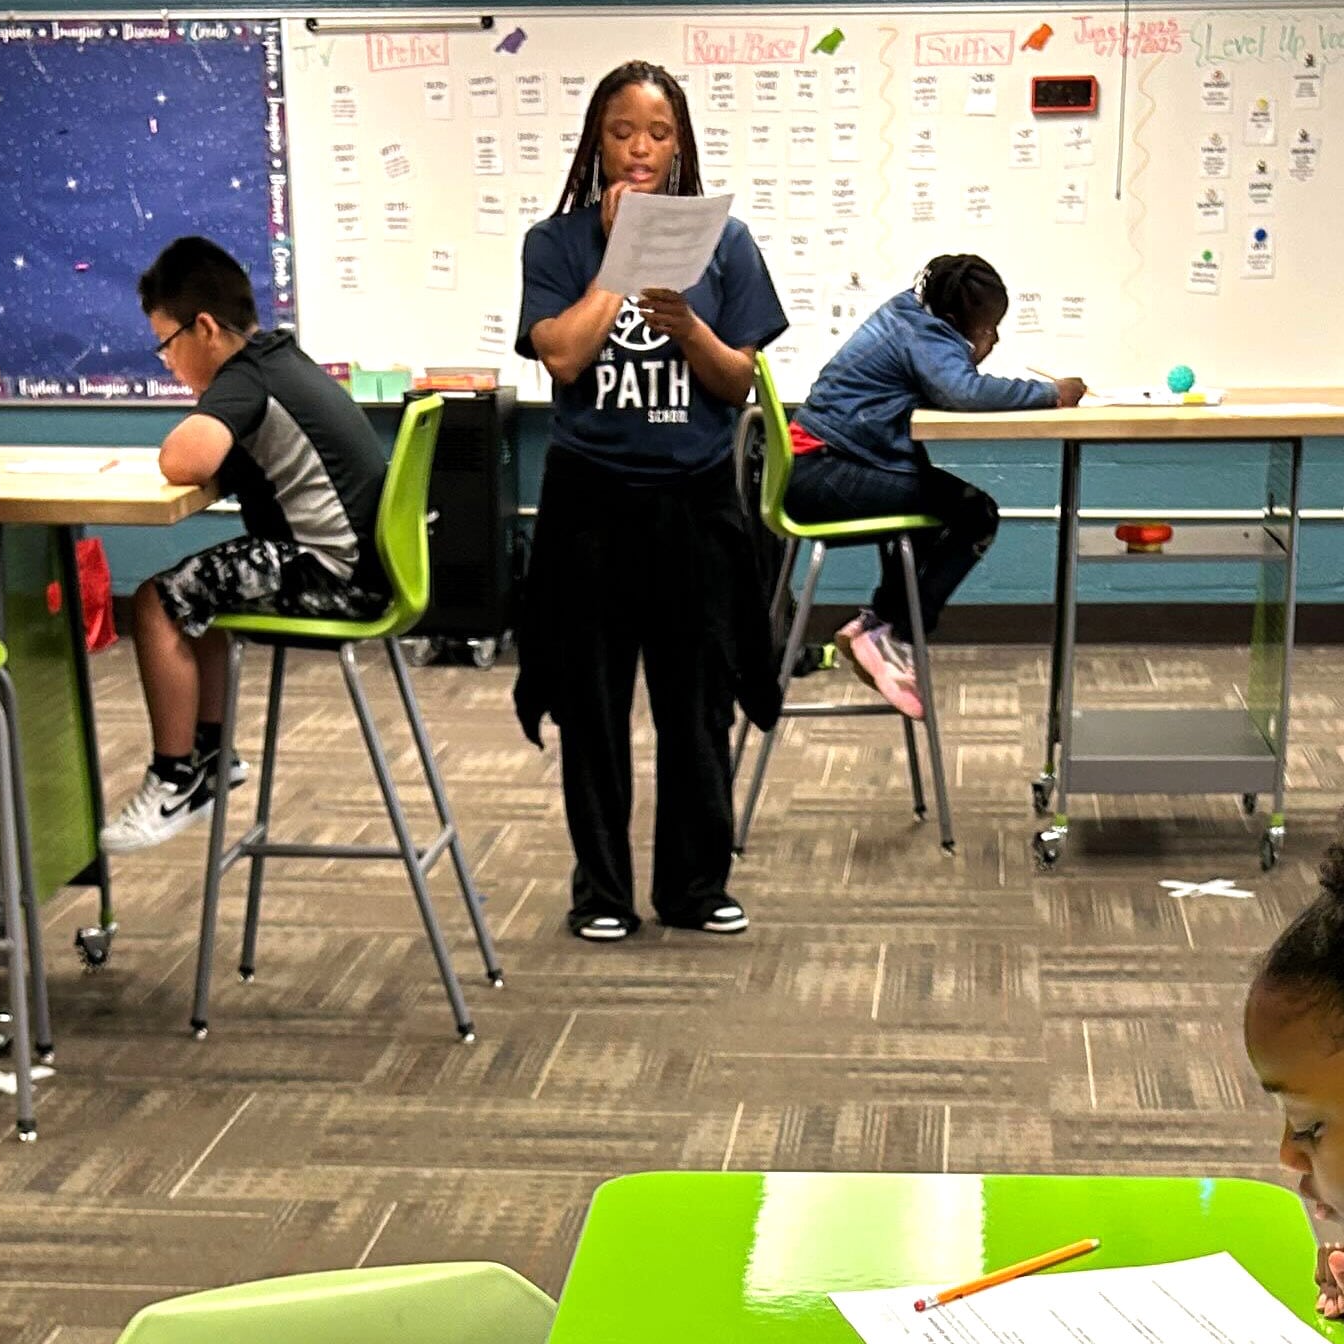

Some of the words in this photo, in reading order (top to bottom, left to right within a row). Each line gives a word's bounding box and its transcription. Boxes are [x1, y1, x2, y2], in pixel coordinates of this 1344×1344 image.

[376, 35, 440, 65] Prefix
[926, 37, 1005, 62] Suffix
[1206, 23, 1266, 60] Level
[1279, 25, 1306, 59] Up
[595, 359, 691, 410] PATH
[647, 409, 689, 423] SCHOOL
